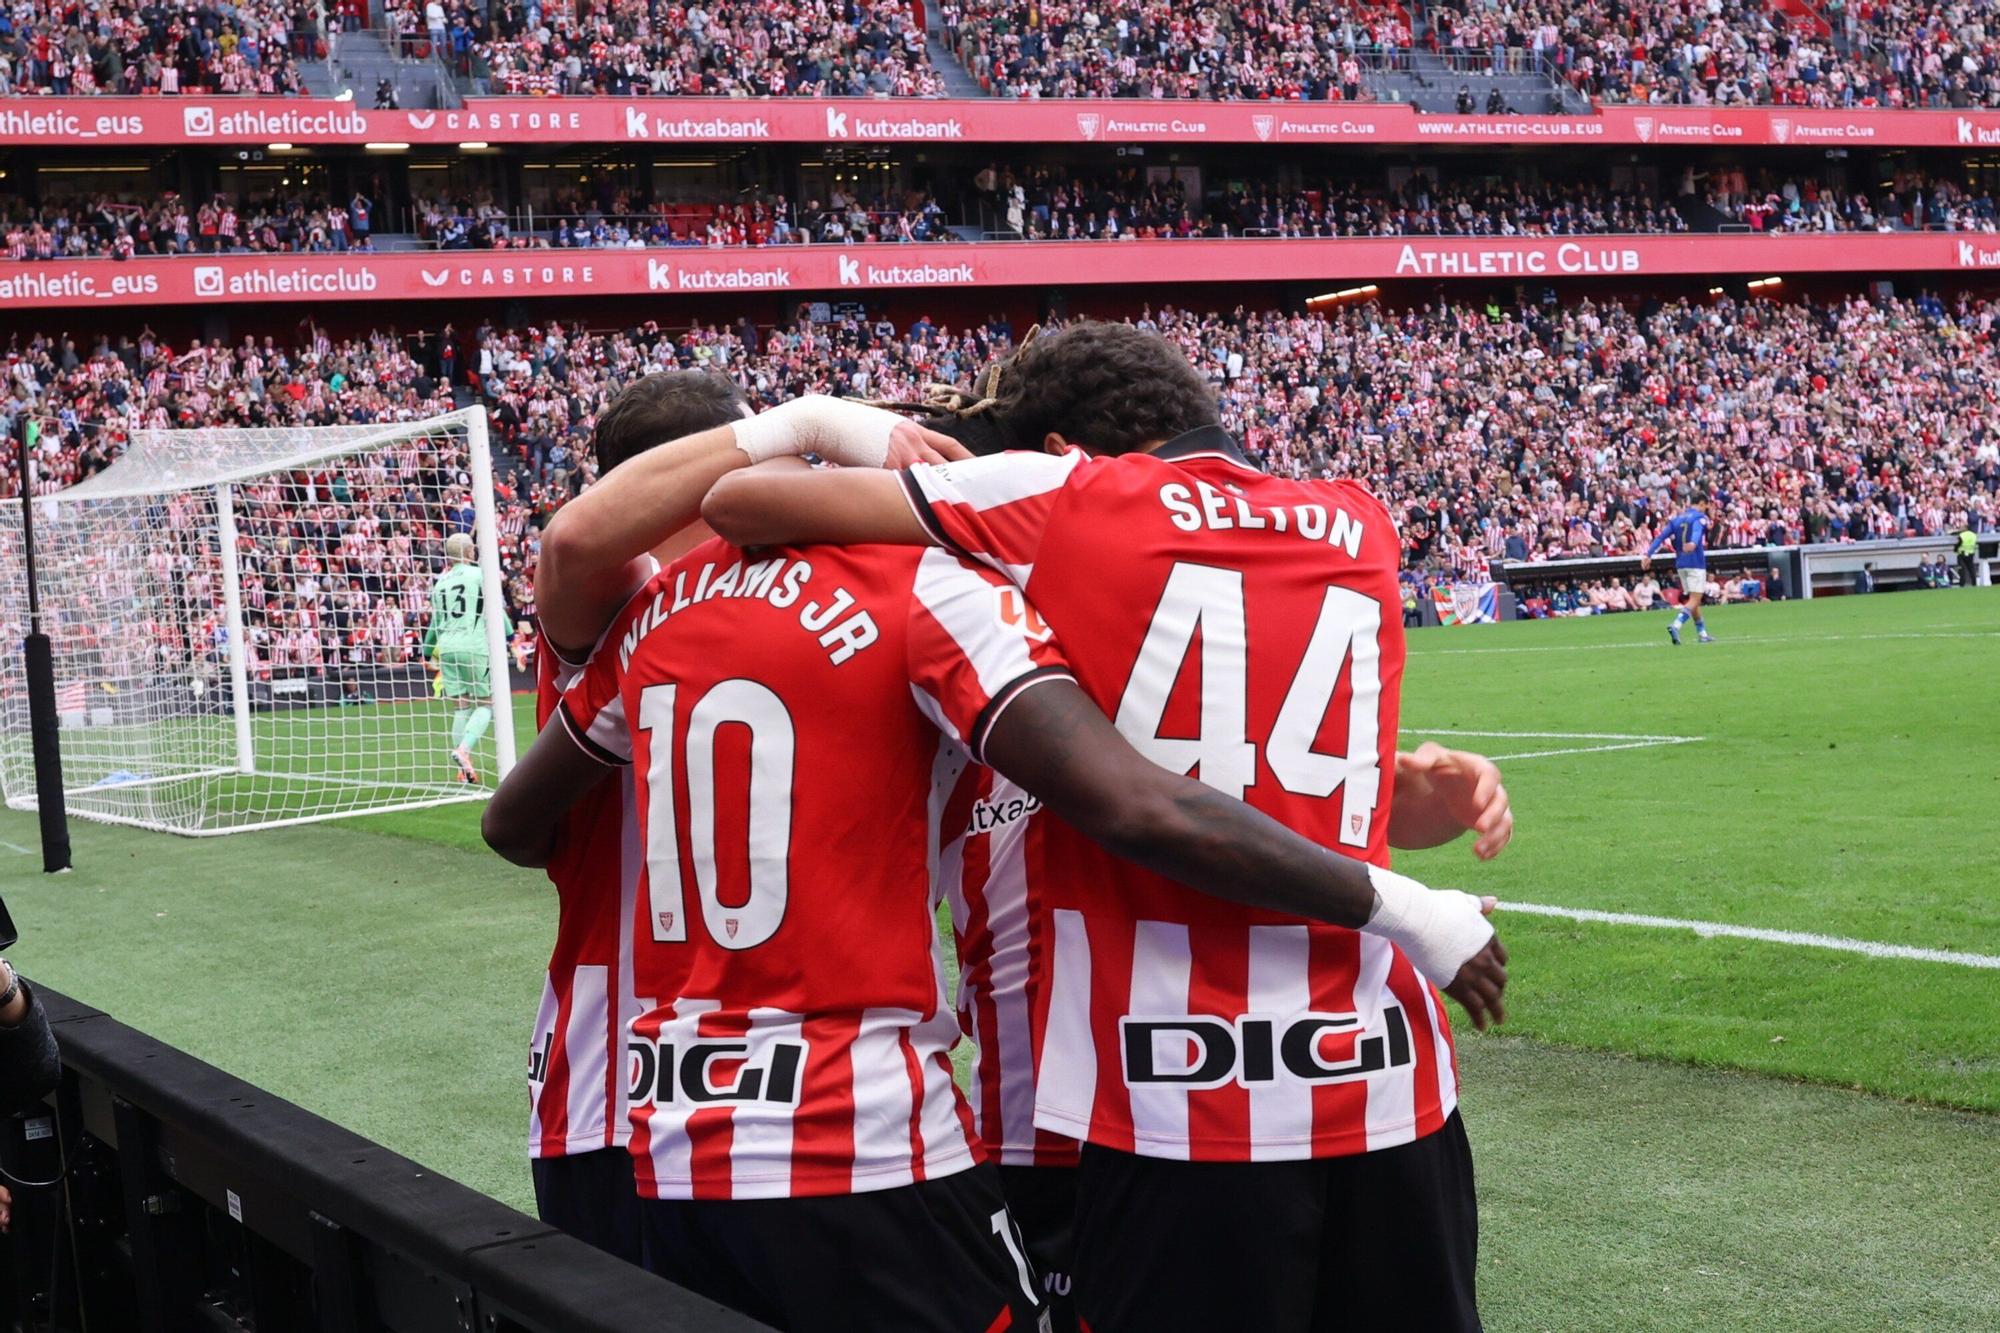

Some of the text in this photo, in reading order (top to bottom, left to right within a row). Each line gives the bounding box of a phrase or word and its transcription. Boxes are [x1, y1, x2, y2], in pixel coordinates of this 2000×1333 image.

[219, 109, 367, 136] athleticclub
[447, 112, 580, 129] CASTORE
[656, 118, 769, 138] kutxabank
[855, 118, 962, 138] kutxabank
[1418, 122, 1603, 136] WWW.ATHLETIC-CLUB.EUS
[0, 271, 159, 298] athletic_eus
[229, 267, 377, 294] athleticclub
[460, 266, 593, 285] CASTORE
[678, 267, 790, 289] kutxabank
[868, 263, 974, 284] kutxabank
[440, 584, 466, 621] 13
[618, 557, 879, 674] WILLIAMS JR
[1114, 560, 1383, 848] 44
[638, 677, 796, 951] 10
[1123, 1006, 1411, 1083] DIGI
[990, 1203, 1040, 1307] 1
